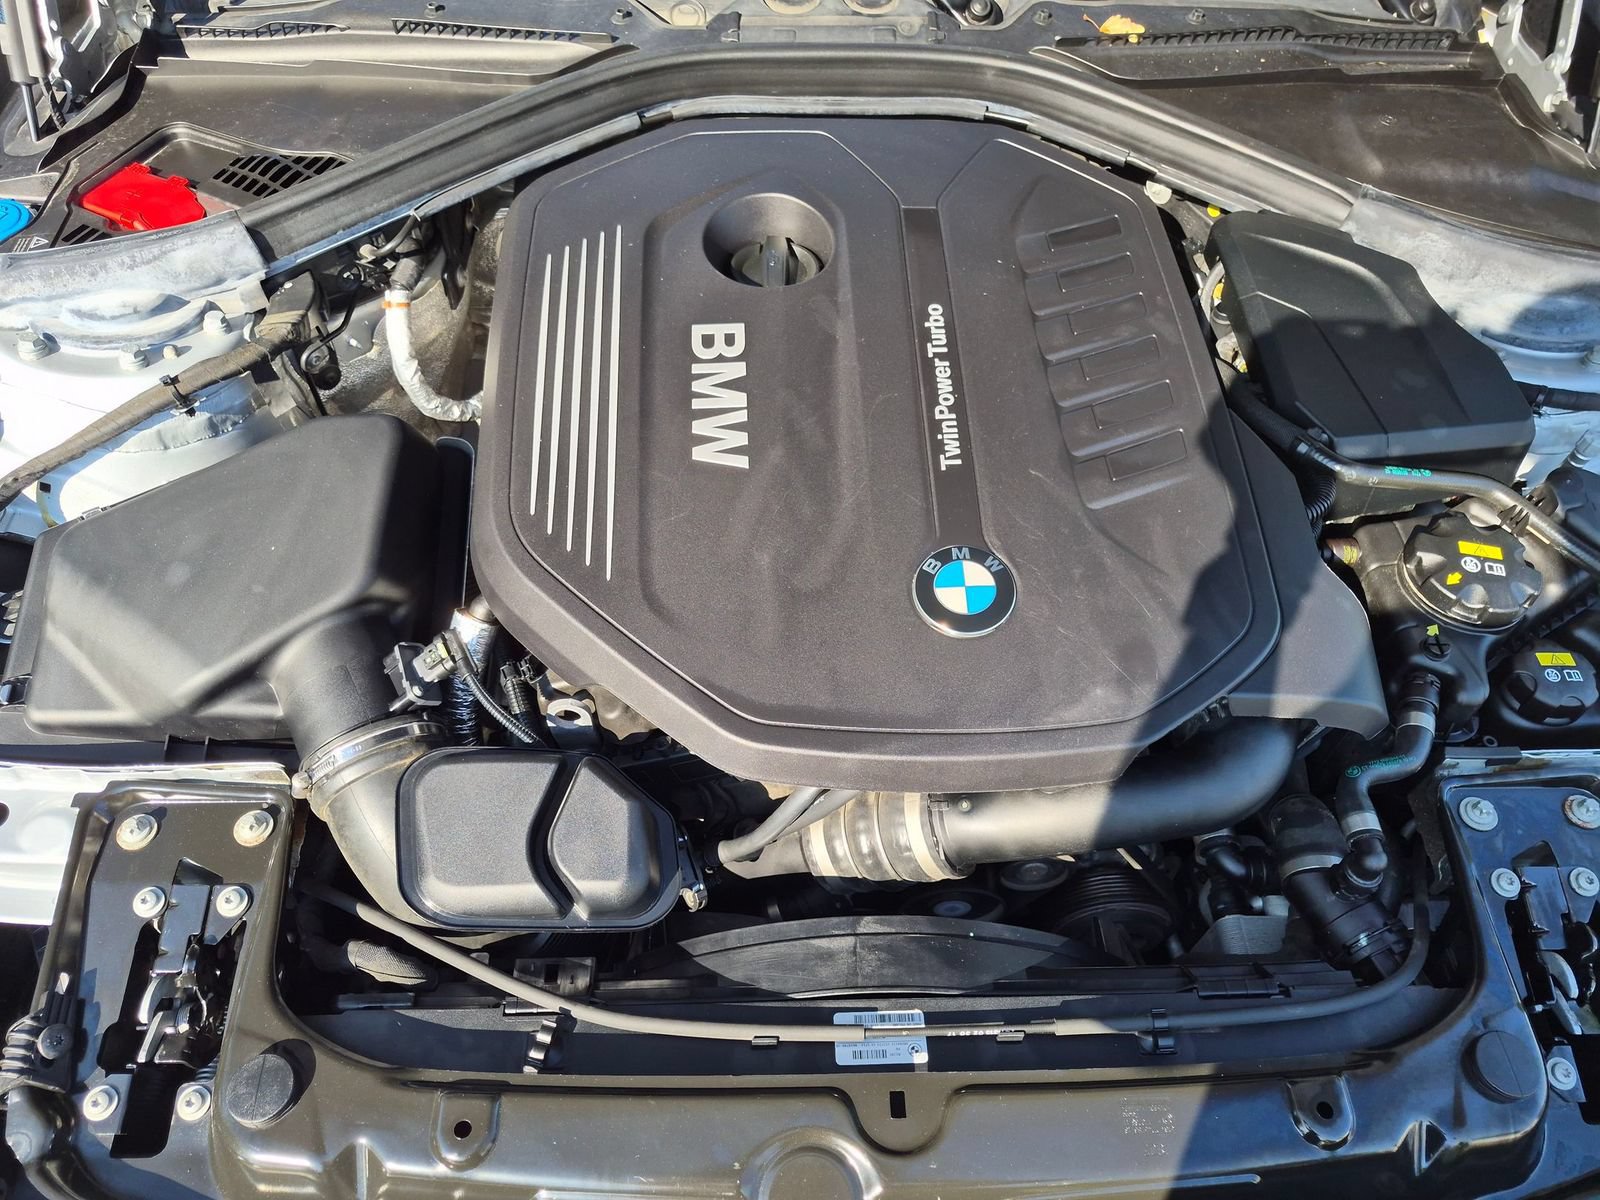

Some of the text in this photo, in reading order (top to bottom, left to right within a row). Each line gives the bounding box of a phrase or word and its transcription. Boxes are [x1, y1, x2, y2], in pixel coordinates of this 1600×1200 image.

[692, 323, 749, 469] BMW
[924, 303, 962, 471] TwinPower Turbo
[922, 547, 1004, 575] BMW
